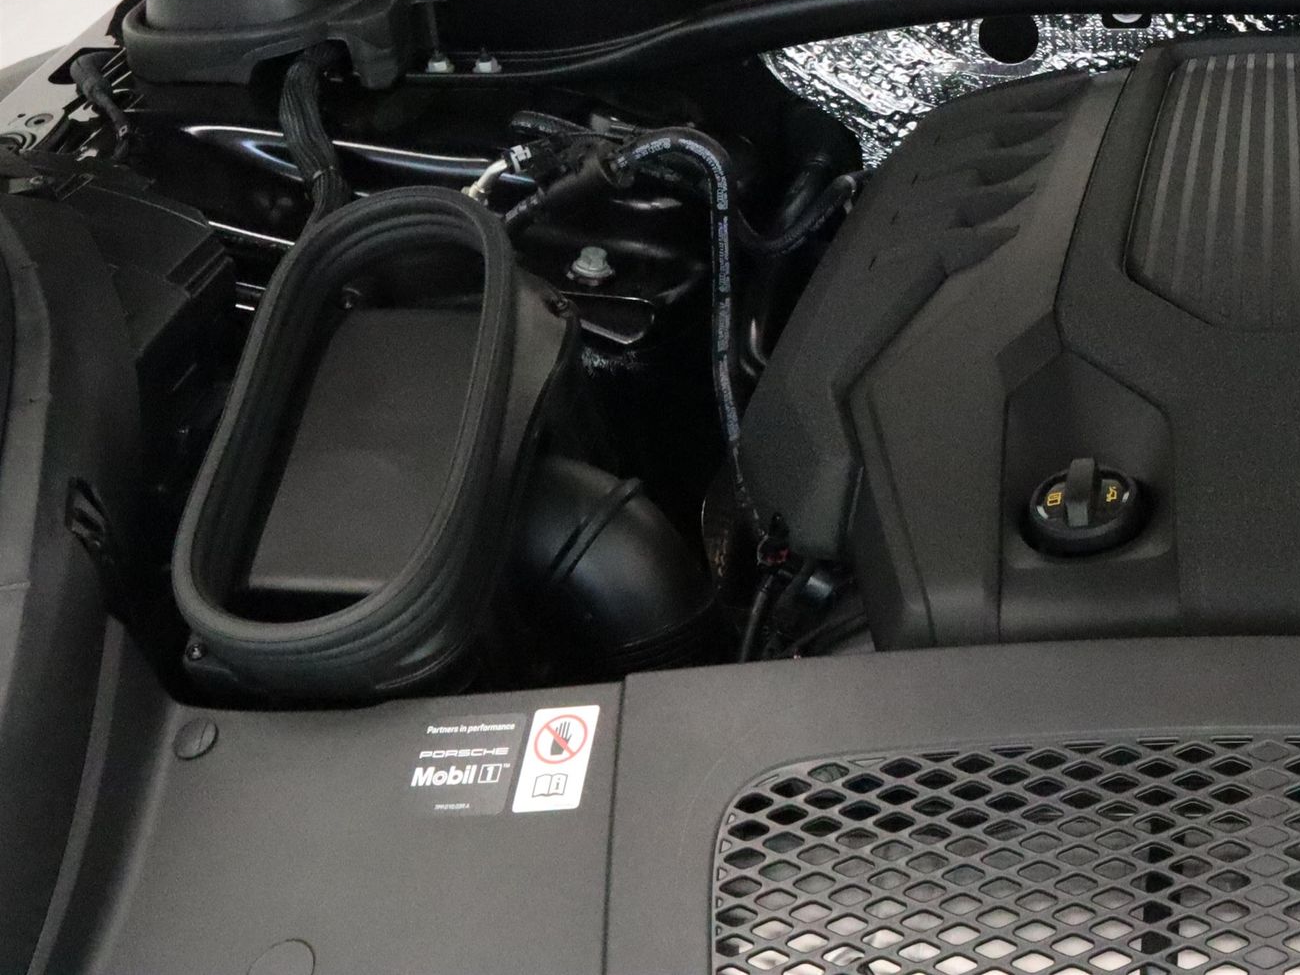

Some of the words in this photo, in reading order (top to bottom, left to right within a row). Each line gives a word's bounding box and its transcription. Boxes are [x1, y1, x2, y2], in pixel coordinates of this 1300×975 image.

[427, 725, 459, 734] Partners
[460, 724, 467, 733] in
[467, 723, 515, 734] performance
[419, 747, 509, 759] PORSCHE
[410, 765, 477, 786] Mobil
